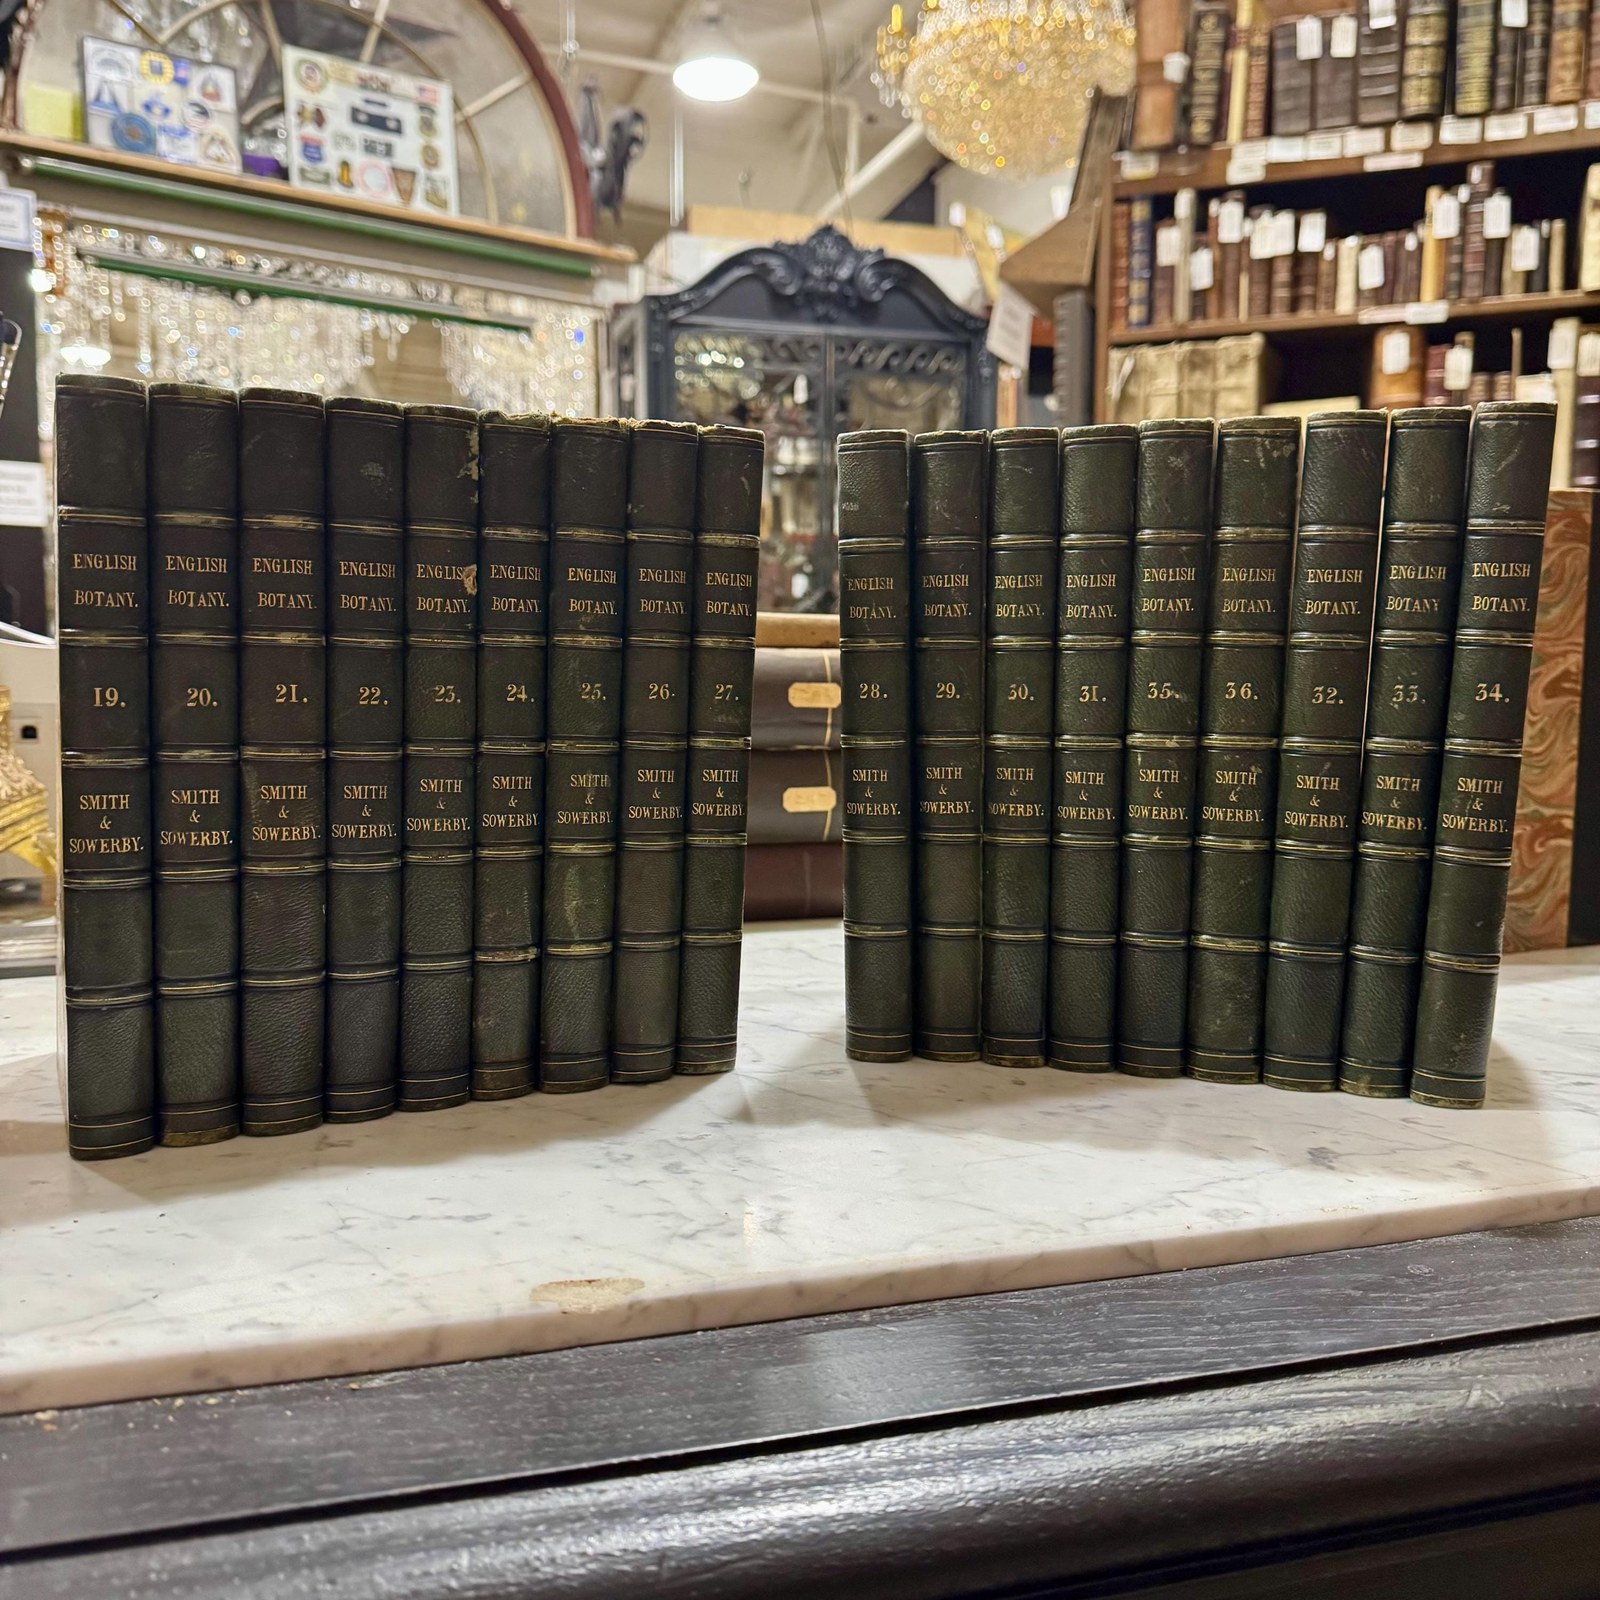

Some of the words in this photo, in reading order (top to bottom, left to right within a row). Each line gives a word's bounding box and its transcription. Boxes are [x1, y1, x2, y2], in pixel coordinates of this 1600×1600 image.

[72, 554, 137, 570] ENGLISH
[166, 555, 228, 573] ENGLISH
[252, 558, 313, 575] ENGLISH
[339, 561, 396, 578] ENGLISH
[416, 564, 477, 579] ENGLIS
[490, 565, 541, 581] ENGLISH
[568, 568, 617, 584] ENGLISH
[639, 568, 686, 584] ENGLISH
[1143, 568, 1195, 583] ENGLISH
[1222, 568, 1276, 582] ENGLISH
[1306, 569, 1363, 584] ENGLISH
[1390, 565, 1446, 580] ENGLISH
[1472, 563, 1531, 578] ENGLISH
[706, 572, 752, 588] ENGLISH
[848, 577, 894, 591] ENGLISH
[923, 575, 969, 588] ENGLISH
[994, 574, 1043, 589] ENGLISH
[1066, 574, 1116, 588] ENGLISH
[74, 590, 139, 608] BOTANY.
[168, 590, 229, 608] BOTANY.
[340, 595, 397, 612] BOTANY.
[416, 597, 471, 613] BOTANY.
[569, 598, 617, 615] BOTANY.
[1142, 597, 1194, 613] BOTANY.
[1222, 598, 1276, 613] BOTANY.
[1472, 595, 1530, 612] BOTANY.
[706, 601, 752, 617] BOTANY.
[849, 606, 896, 620] BOTANY.
[924, 603, 972, 618] BOTANY.
[1066, 604, 1117, 619] BOTANY.
[1305, 600, 1361, 615] BOTANY.
[93, 688, 126, 707] 19.
[187, 688, 218, 707] 20.
[275, 684, 308, 703] 21.
[359, 687, 388, 705] 22.
[433, 685, 461, 703] 23.
[506, 684, 535, 702] 24.
[581, 683, 606, 701] 25.
[649, 683, 676, 699] 26.
[714, 684, 739, 701] 27.
[859, 683, 888, 699] 28.
[935, 682, 960, 699] 29.
[1008, 685, 1034, 701] 30.
[1079, 686, 1107, 702] 31.
[1225, 683, 1258, 700] 36.
[1312, 686, 1344, 705] 32.
[1392, 685, 1426, 702] 33.
[1475, 683, 1510, 702] 34.
[637, 770, 675, 783] SMITH
[702, 770, 739, 782] SMITH
[853, 769, 888, 782] SMITH
[926, 767, 962, 780] SMITH
[996, 768, 1034, 781] SMITH
[1065, 771, 1105, 785] SMITH
[1139, 769, 1179, 783] SMITH
[1215, 771, 1258, 785] SMITH
[420, 779, 463, 793] SMITH
[492, 776, 533, 790] SMITH
[570, 775, 609, 788] SMITH
[1296, 776, 1340, 791] SMITH
[1376, 776, 1420, 792] SMITH
[1457, 777, 1502, 794] SMITH
[171, 790, 220, 804] SMITH
[261, 785, 308, 800] SMITH
[343, 785, 387, 799] SMITH
[652, 787, 661, 798] &
[716, 787, 725, 798] &
[865, 787, 874, 798] &
[939, 785, 947, 796] &
[1010, 786, 1019, 797] &
[1079, 789, 1088, 801] &
[1153, 787, 1163, 798] &
[1229, 791, 1238, 802] &
[80, 795, 130, 810] SMITH
[437, 798, 446, 809] &
[508, 796, 518, 807] &
[585, 794, 594, 805] &
[1310, 795, 1320, 807] &
[1390, 797, 1401, 809] &
[1472, 798, 1483, 811] &
[279, 806, 289, 818] &
[362, 805, 372, 817] &
[628, 806, 683, 820] SOWERBY.
[847, 802, 901, 816] SOWERBY.
[1057, 805, 1116, 820] SOWERBY.
[1128, 804, 1188, 820] SOWERBY.
[1202, 806, 1264, 823] SOWERBY.
[100, 817, 112, 830] &
[190, 811, 201, 823] &
[1285, 811, 1349, 828] SOWERBY.
[1362, 812, 1427, 831] SOWERBY.
[1442, 814, 1508, 833] SOWERBY.
[332, 824, 397, 839] SOWERBY.
[406, 818, 470, 832] SOWERBY.
[160, 831, 233, 846] SOWERBY.
[252, 826, 321, 841] SOWERBY.
[69, 836, 144, 854] SOWERBY.
